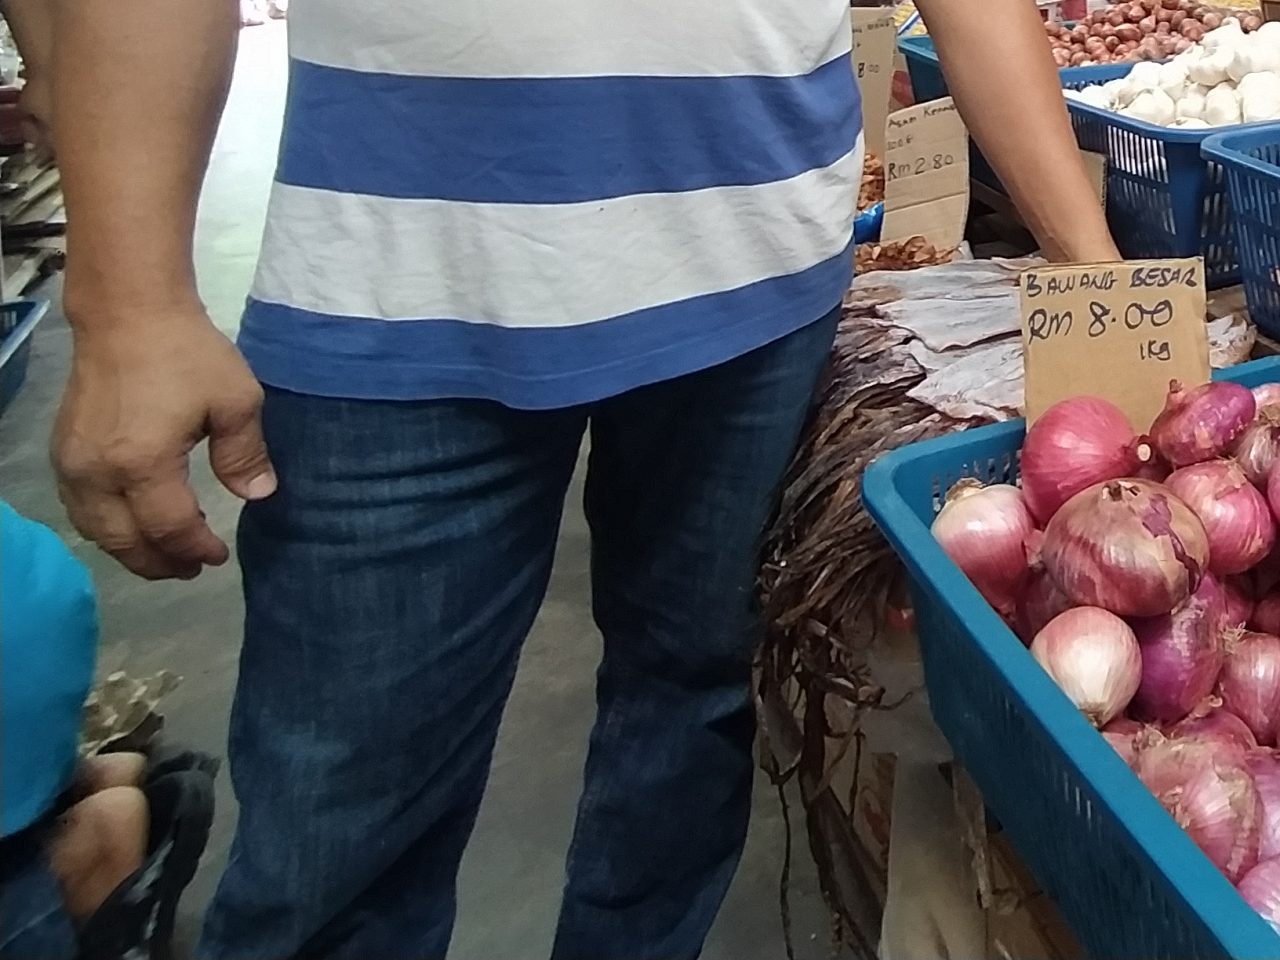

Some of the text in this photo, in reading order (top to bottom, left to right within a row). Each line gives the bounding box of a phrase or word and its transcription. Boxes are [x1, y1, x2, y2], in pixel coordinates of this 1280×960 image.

[1026, 266, 1199, 298] BAWANG BESAR
[1087, 299, 1174, 337] 8.00
